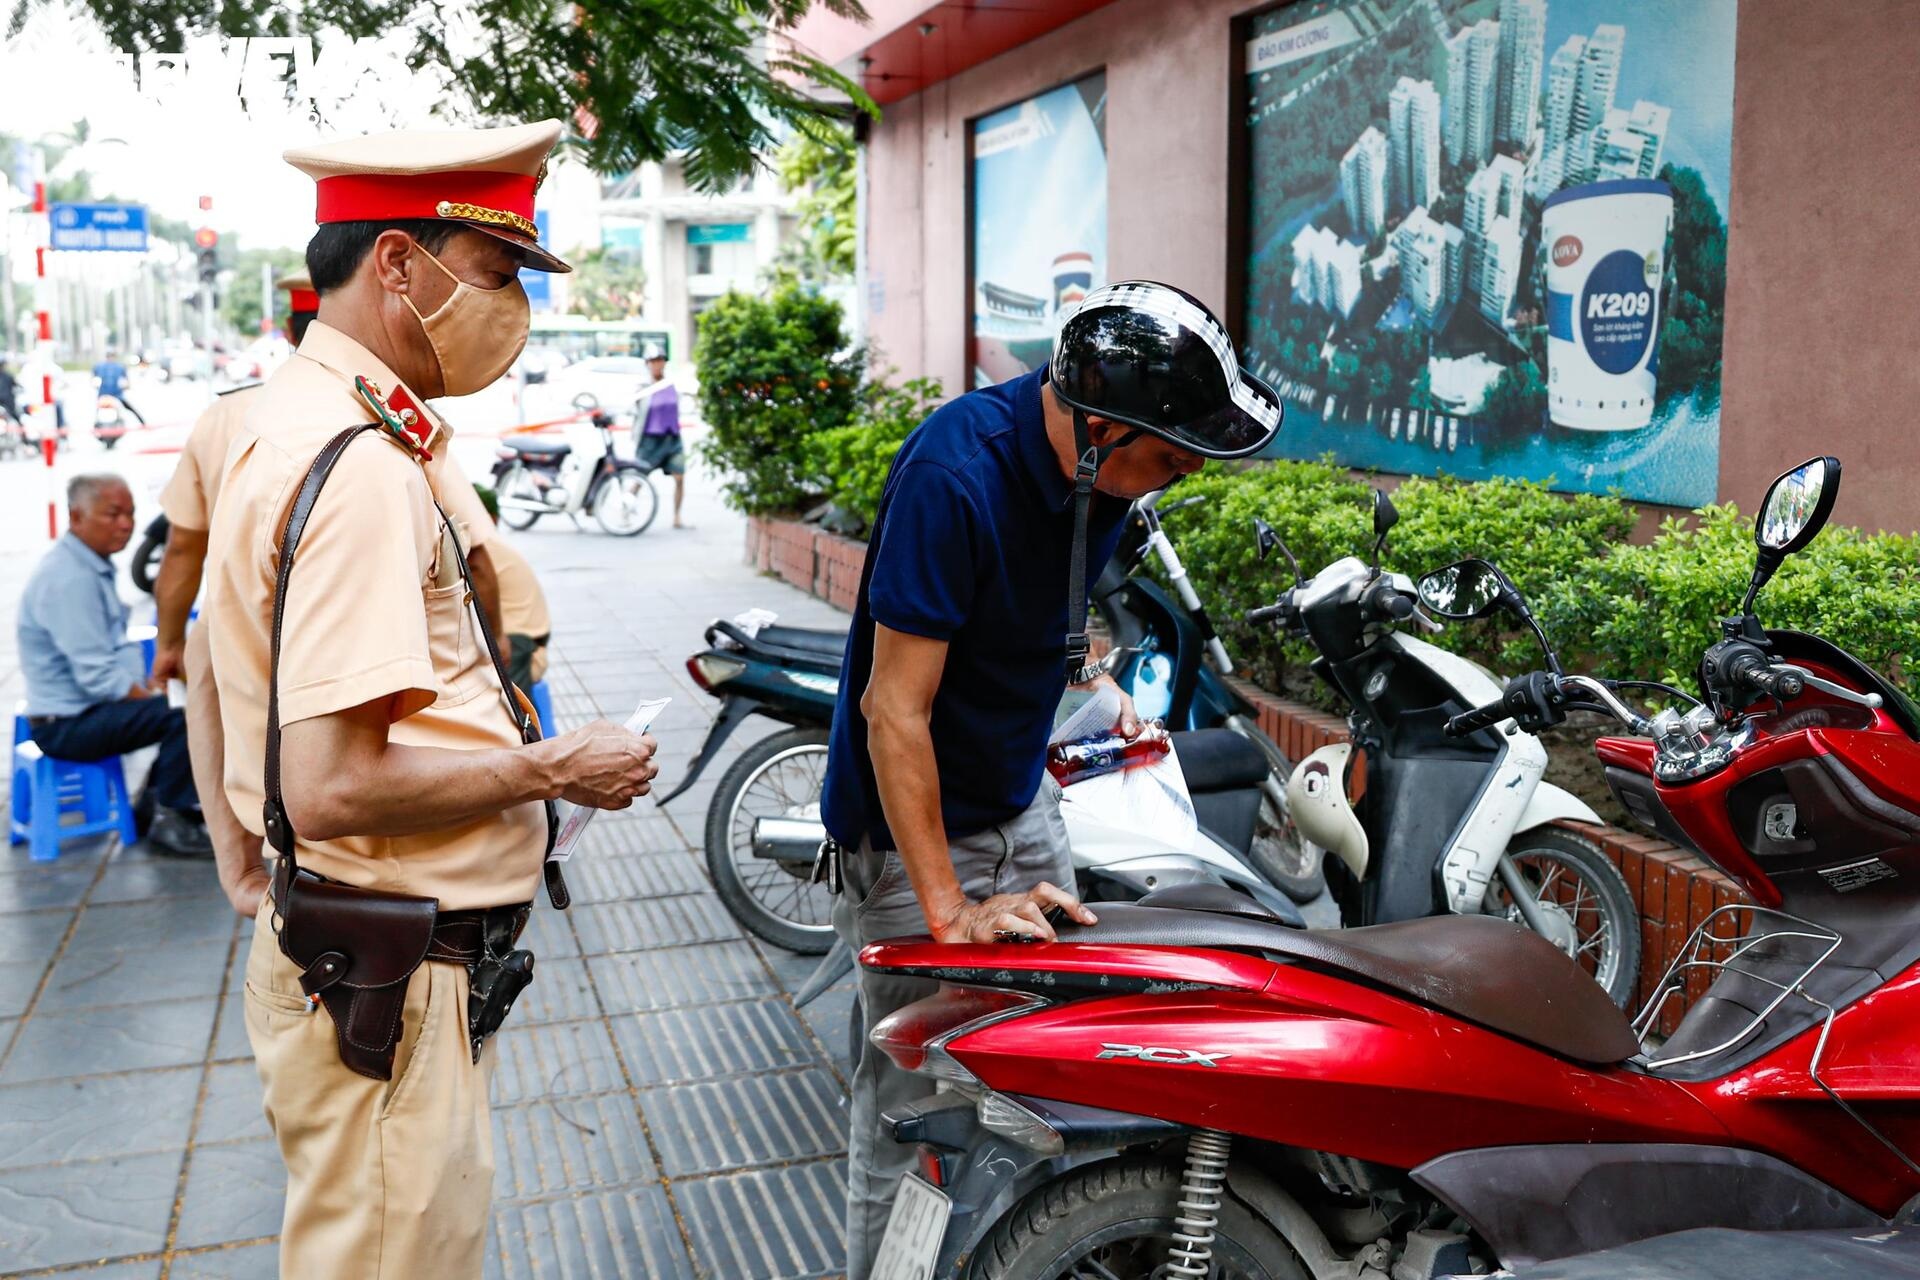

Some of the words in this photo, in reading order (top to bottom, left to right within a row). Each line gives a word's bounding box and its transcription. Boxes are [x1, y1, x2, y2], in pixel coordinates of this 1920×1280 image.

[1278, 37, 1295, 53] KIM
[1587, 291, 1651, 319] K209
[1096, 1042, 1233, 1067] PCX
